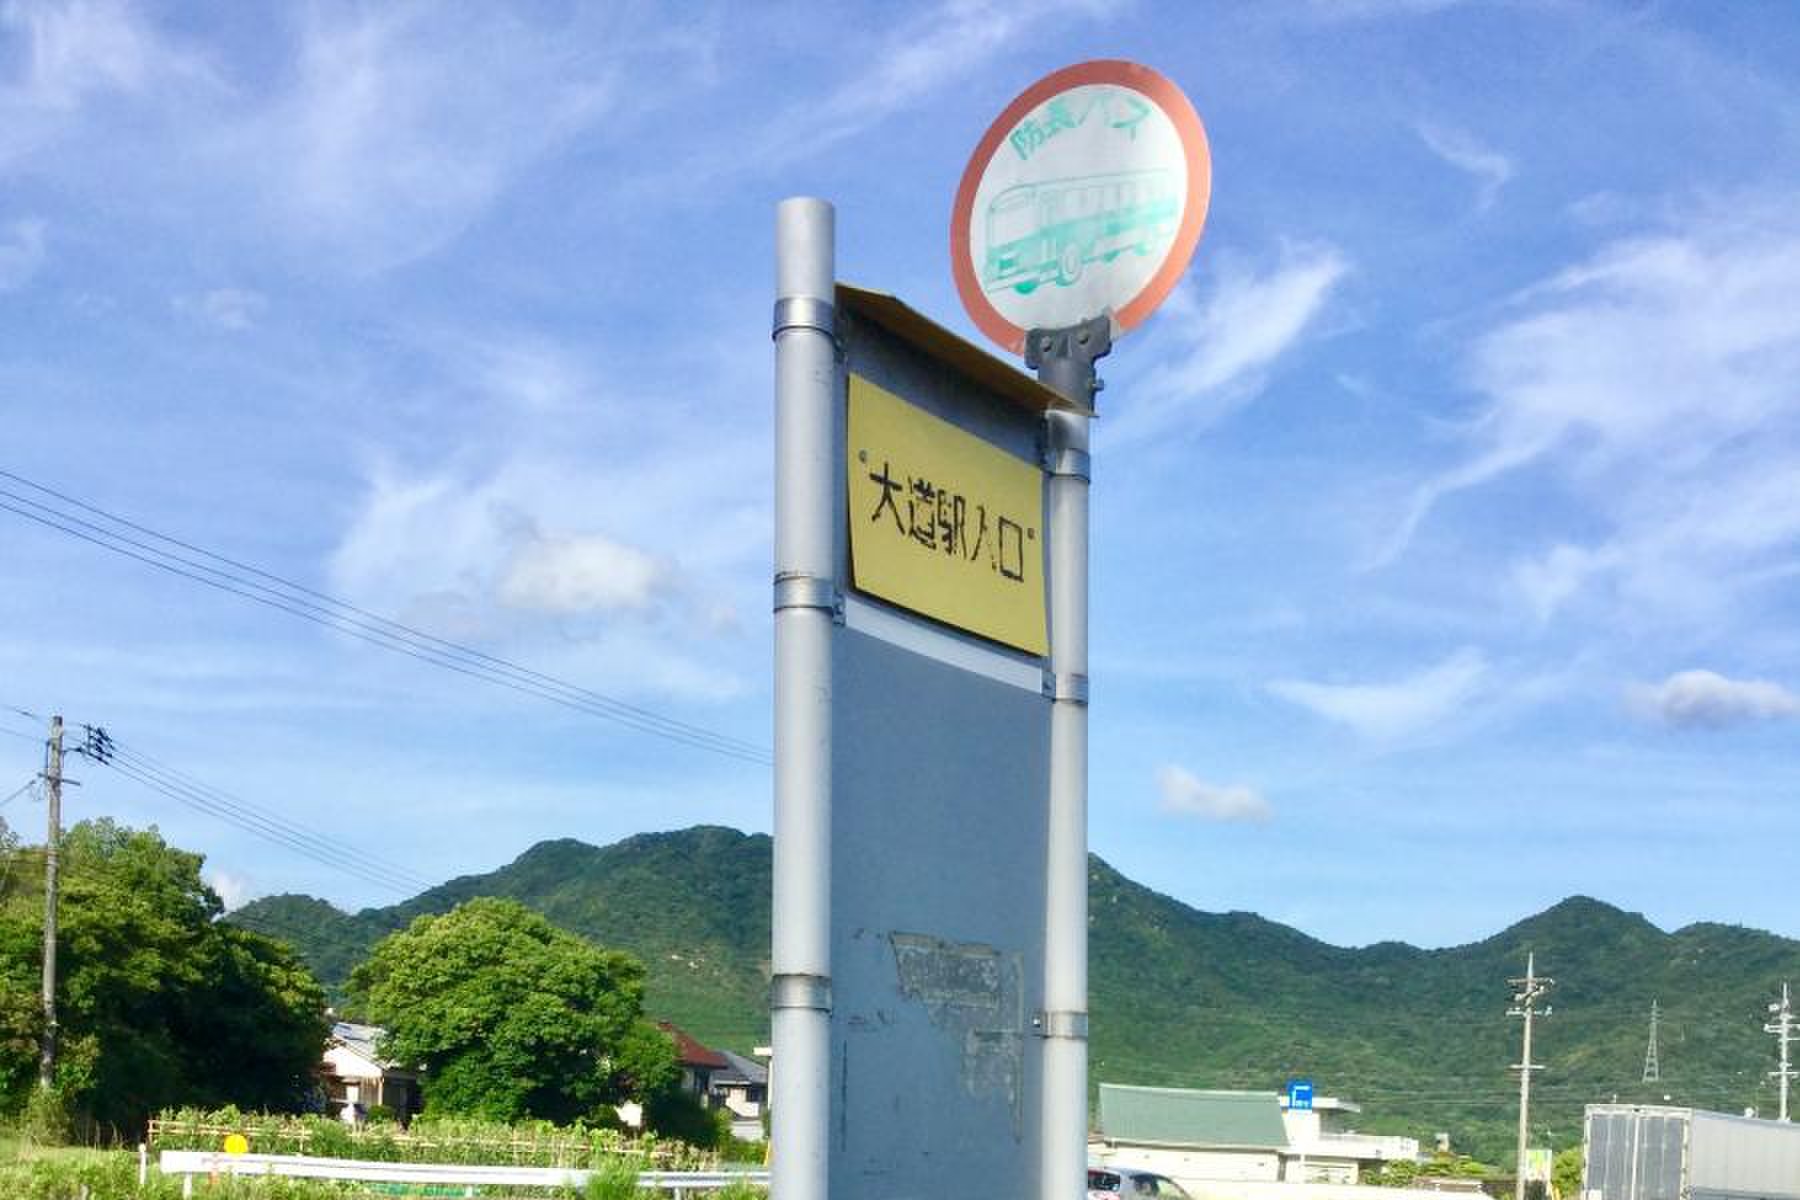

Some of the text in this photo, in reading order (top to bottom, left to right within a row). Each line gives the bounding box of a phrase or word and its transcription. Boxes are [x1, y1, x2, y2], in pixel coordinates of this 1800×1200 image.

[869, 461, 1024, 582] 大道駅入口
